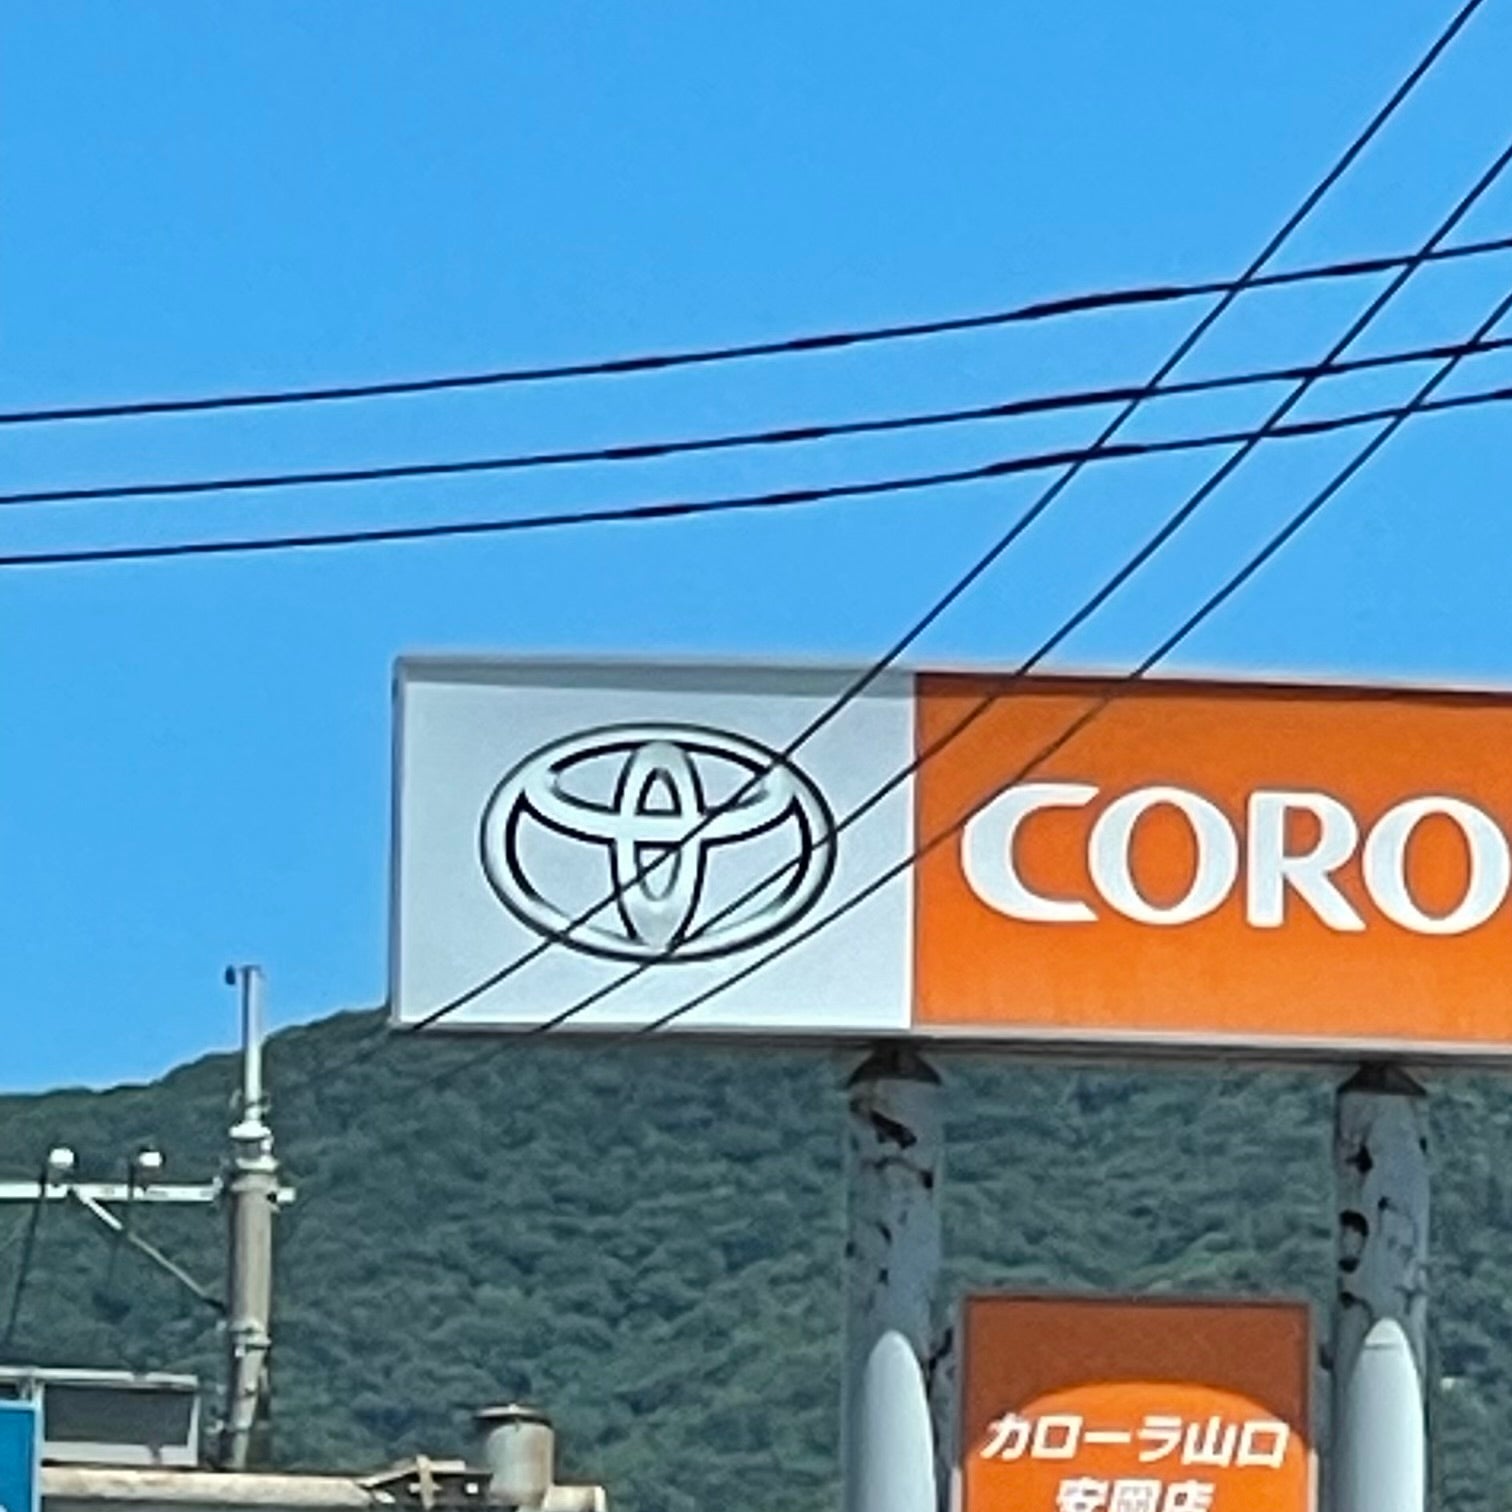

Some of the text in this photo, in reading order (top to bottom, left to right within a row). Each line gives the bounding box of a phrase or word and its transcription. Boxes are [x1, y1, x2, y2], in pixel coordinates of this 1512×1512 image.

[980, 1412, 1291, 1467] カローラ山口
